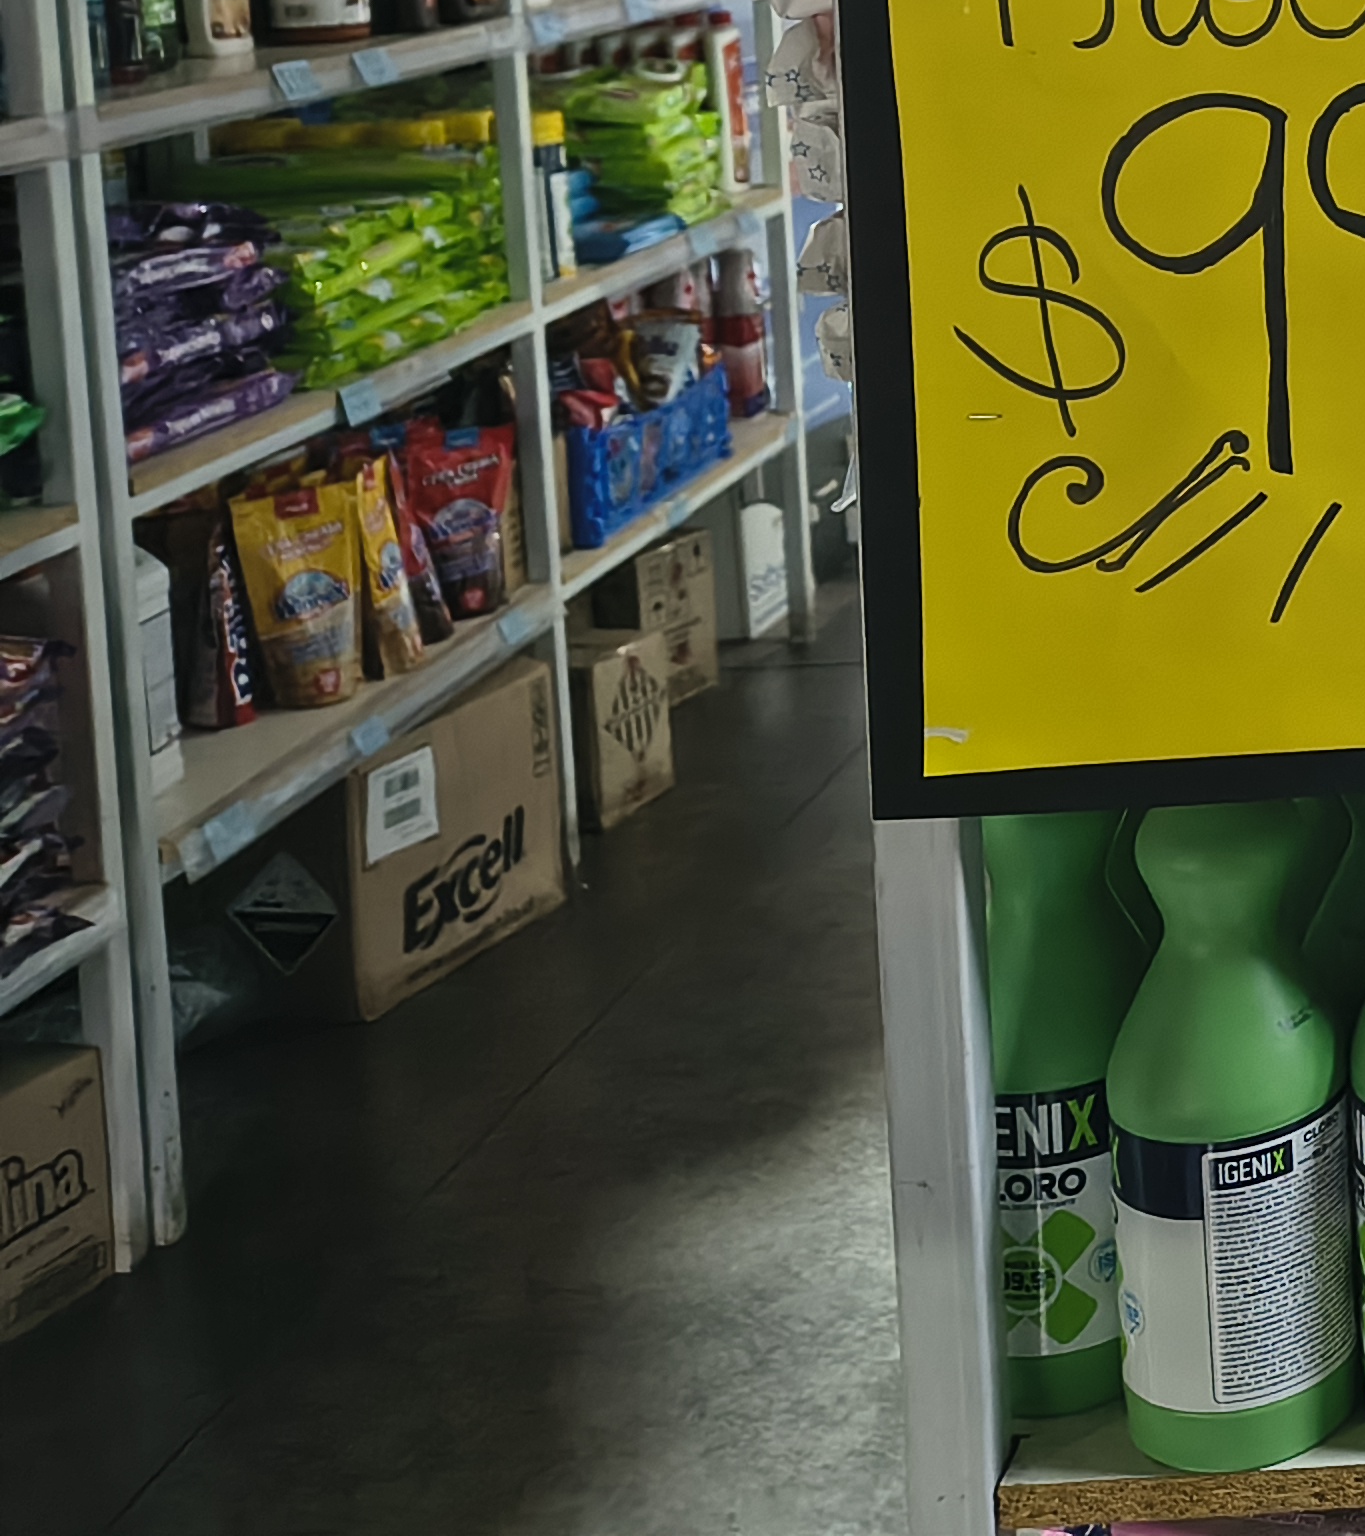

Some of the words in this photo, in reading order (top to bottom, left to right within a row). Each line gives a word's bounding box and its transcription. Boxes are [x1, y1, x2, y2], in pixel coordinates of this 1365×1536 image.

[402, 803, 525, 954] Excell
[995, 1093, 1099, 1157] ENIX
[1217, 1147, 1285, 1186] IGENIX
